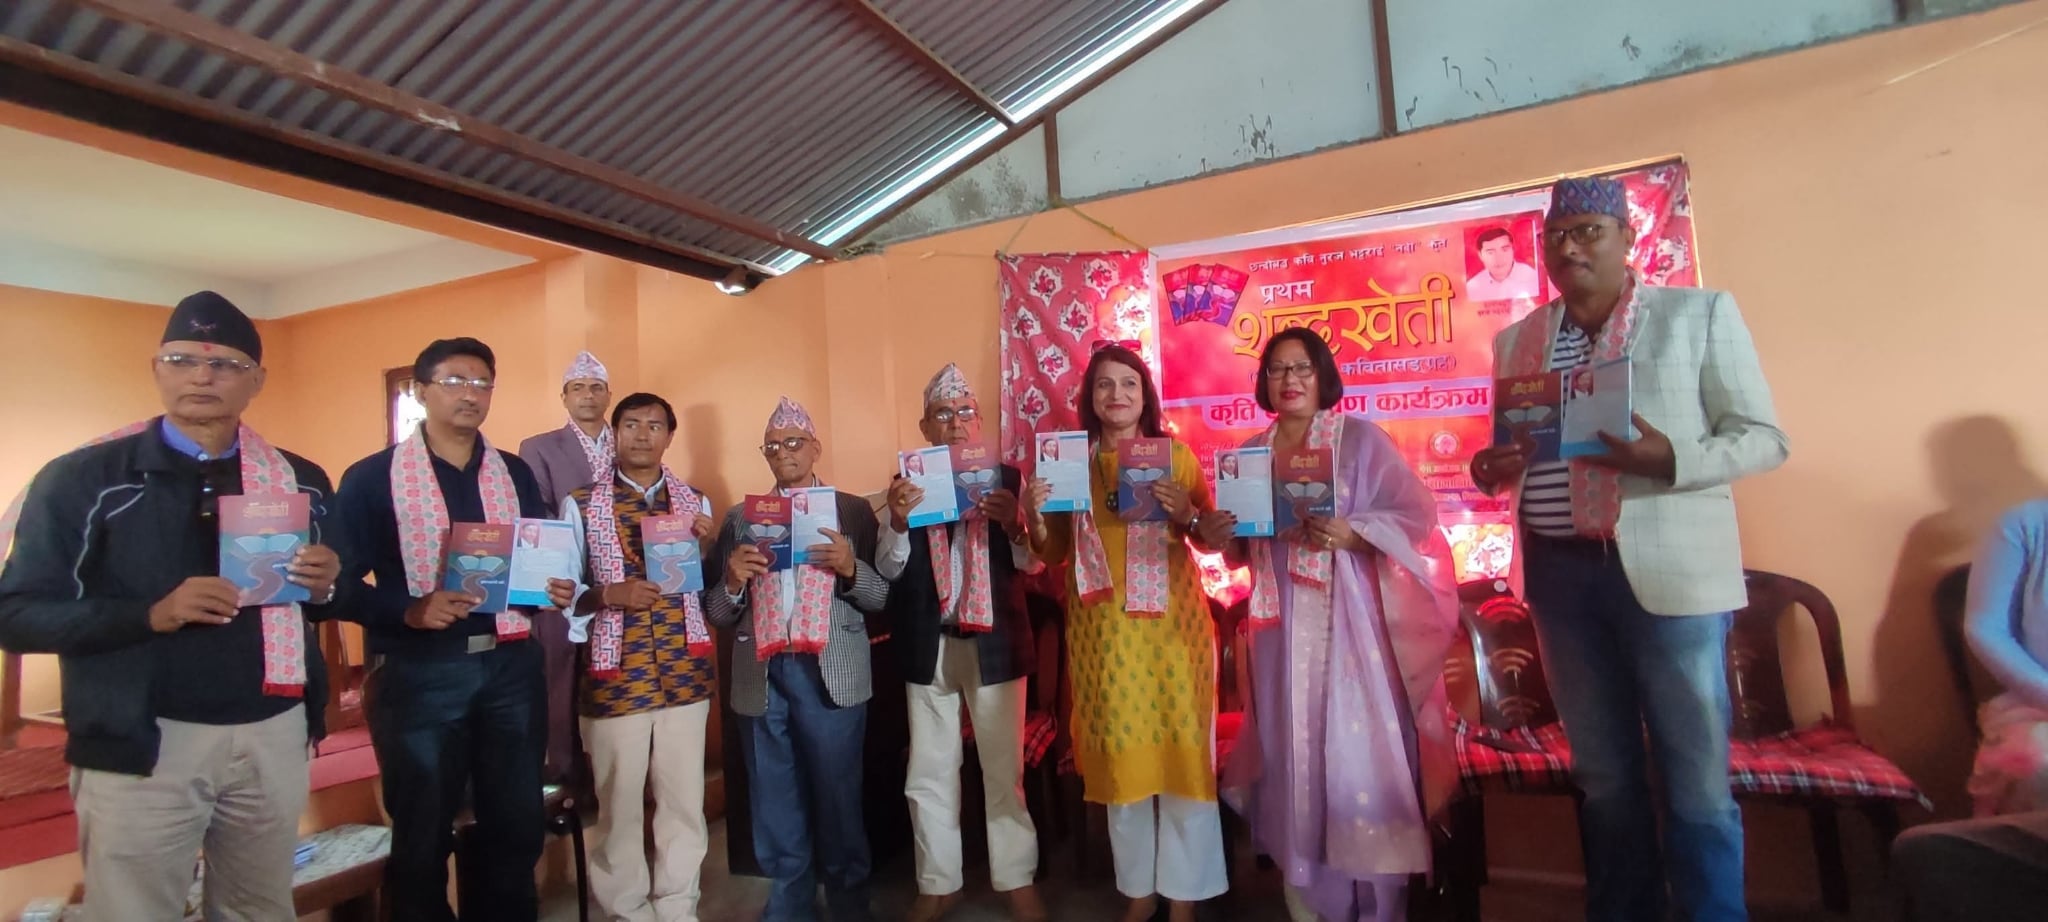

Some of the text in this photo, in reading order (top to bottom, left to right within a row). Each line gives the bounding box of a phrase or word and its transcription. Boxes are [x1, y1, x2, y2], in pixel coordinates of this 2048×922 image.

[1260, 280, 1315, 303] प्रथम
[1211, 397, 1256, 426] कृति
[1376, 386, 1489, 411] कार्यक्रम
